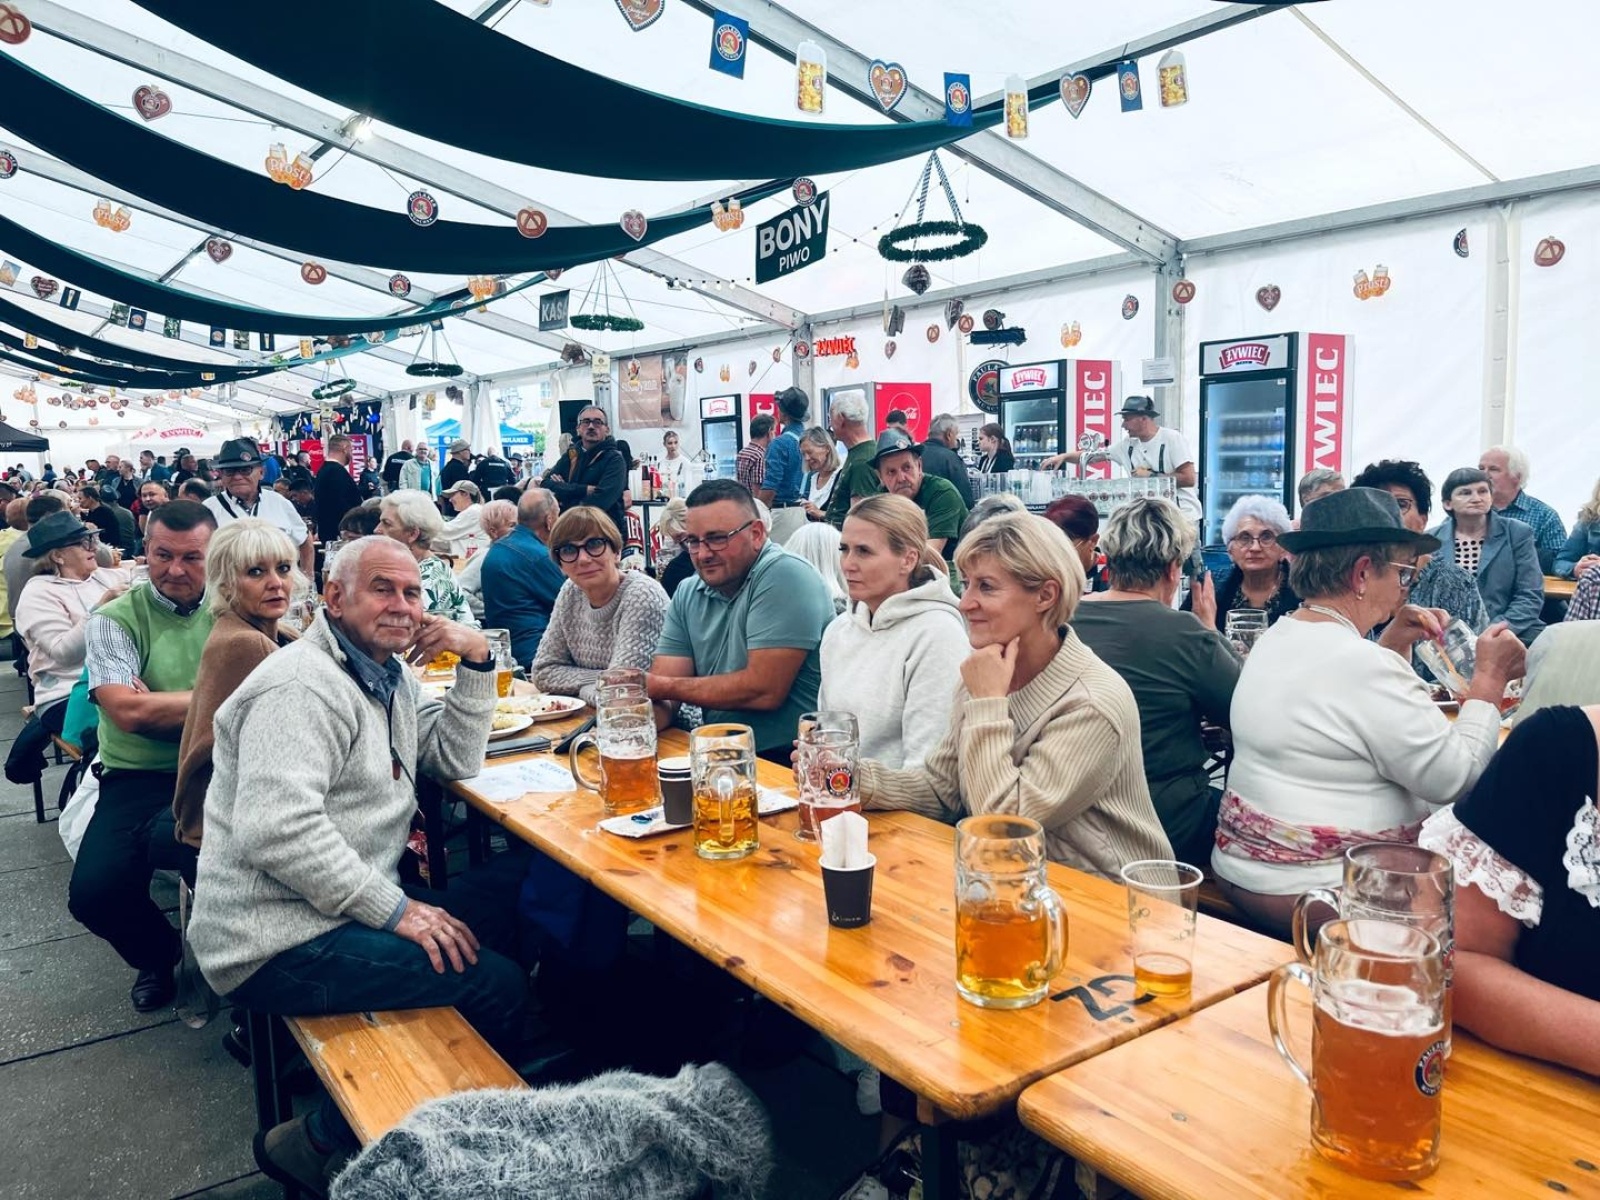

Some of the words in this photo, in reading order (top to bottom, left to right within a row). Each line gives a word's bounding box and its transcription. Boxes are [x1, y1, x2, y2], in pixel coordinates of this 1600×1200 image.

[759, 198, 827, 259] BONY
[779, 246, 810, 272] PIWO
[972, 364, 998, 382] PAULA
